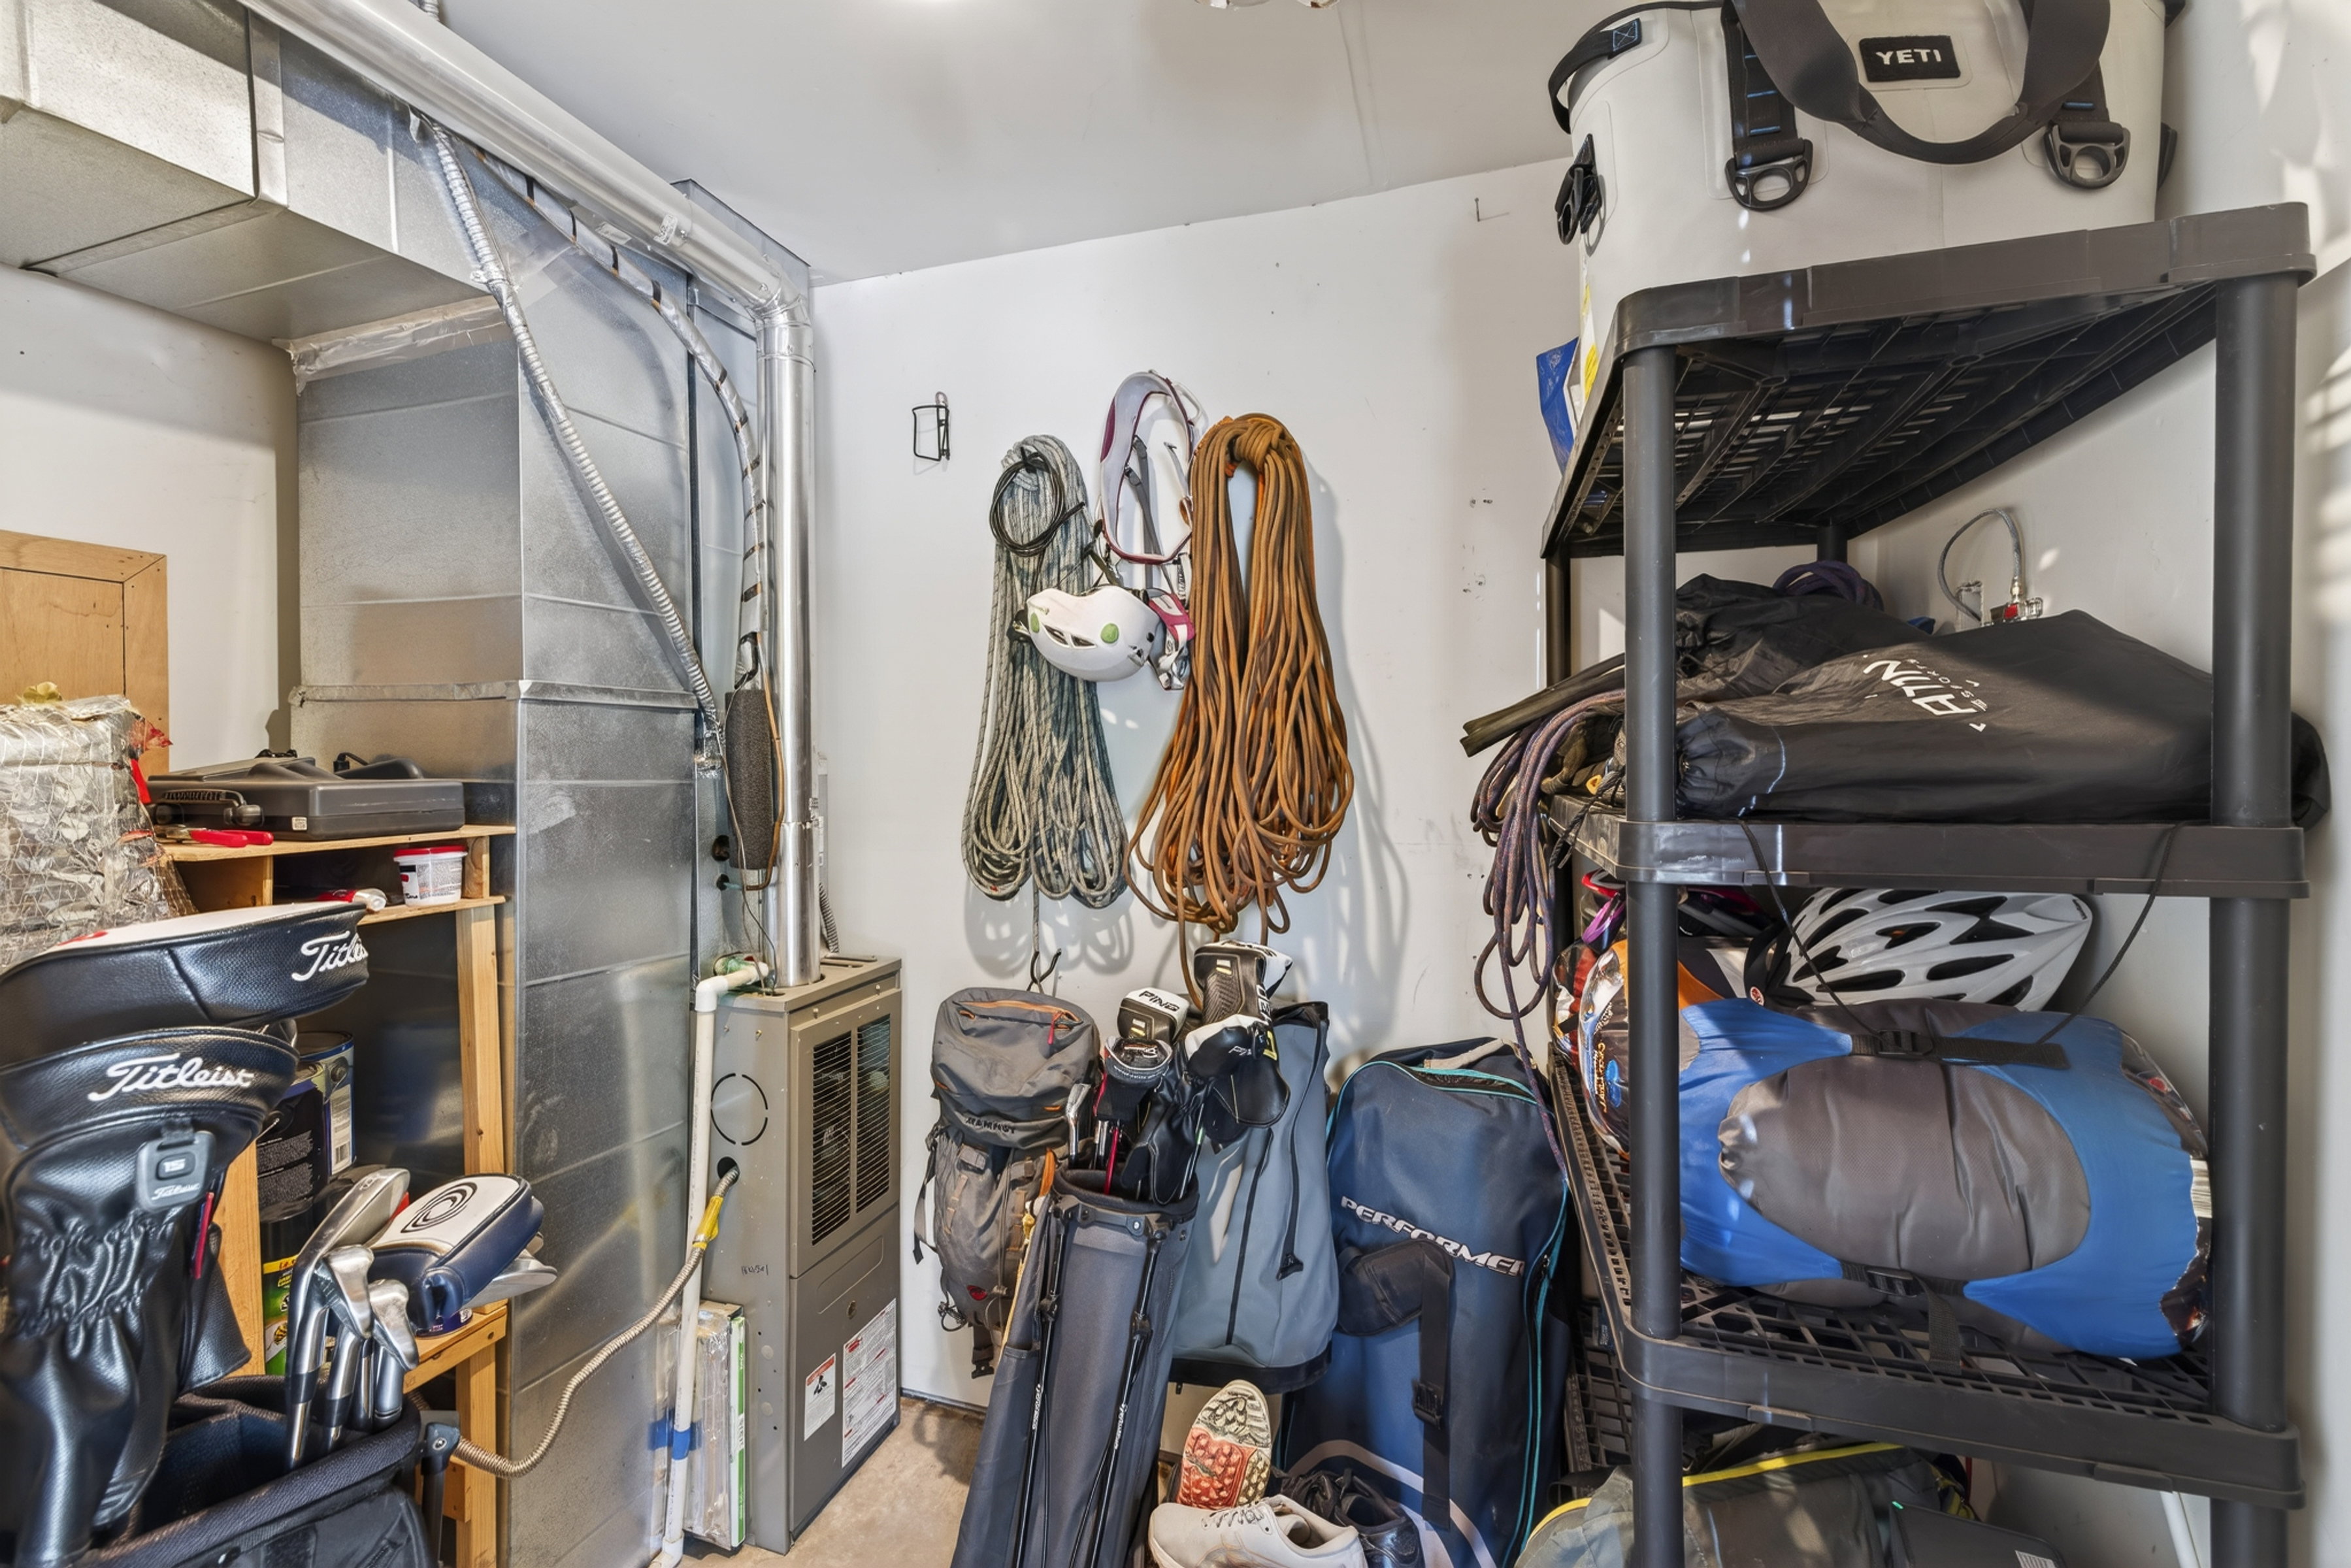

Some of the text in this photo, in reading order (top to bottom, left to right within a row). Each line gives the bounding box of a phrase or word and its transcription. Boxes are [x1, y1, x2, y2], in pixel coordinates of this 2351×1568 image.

[1875, 48, 1942, 65] YETI
[291, 930, 369, 981] Titleis
[1138, 990, 1180, 1012] PING
[88, 1053, 254, 1102] Titleist
